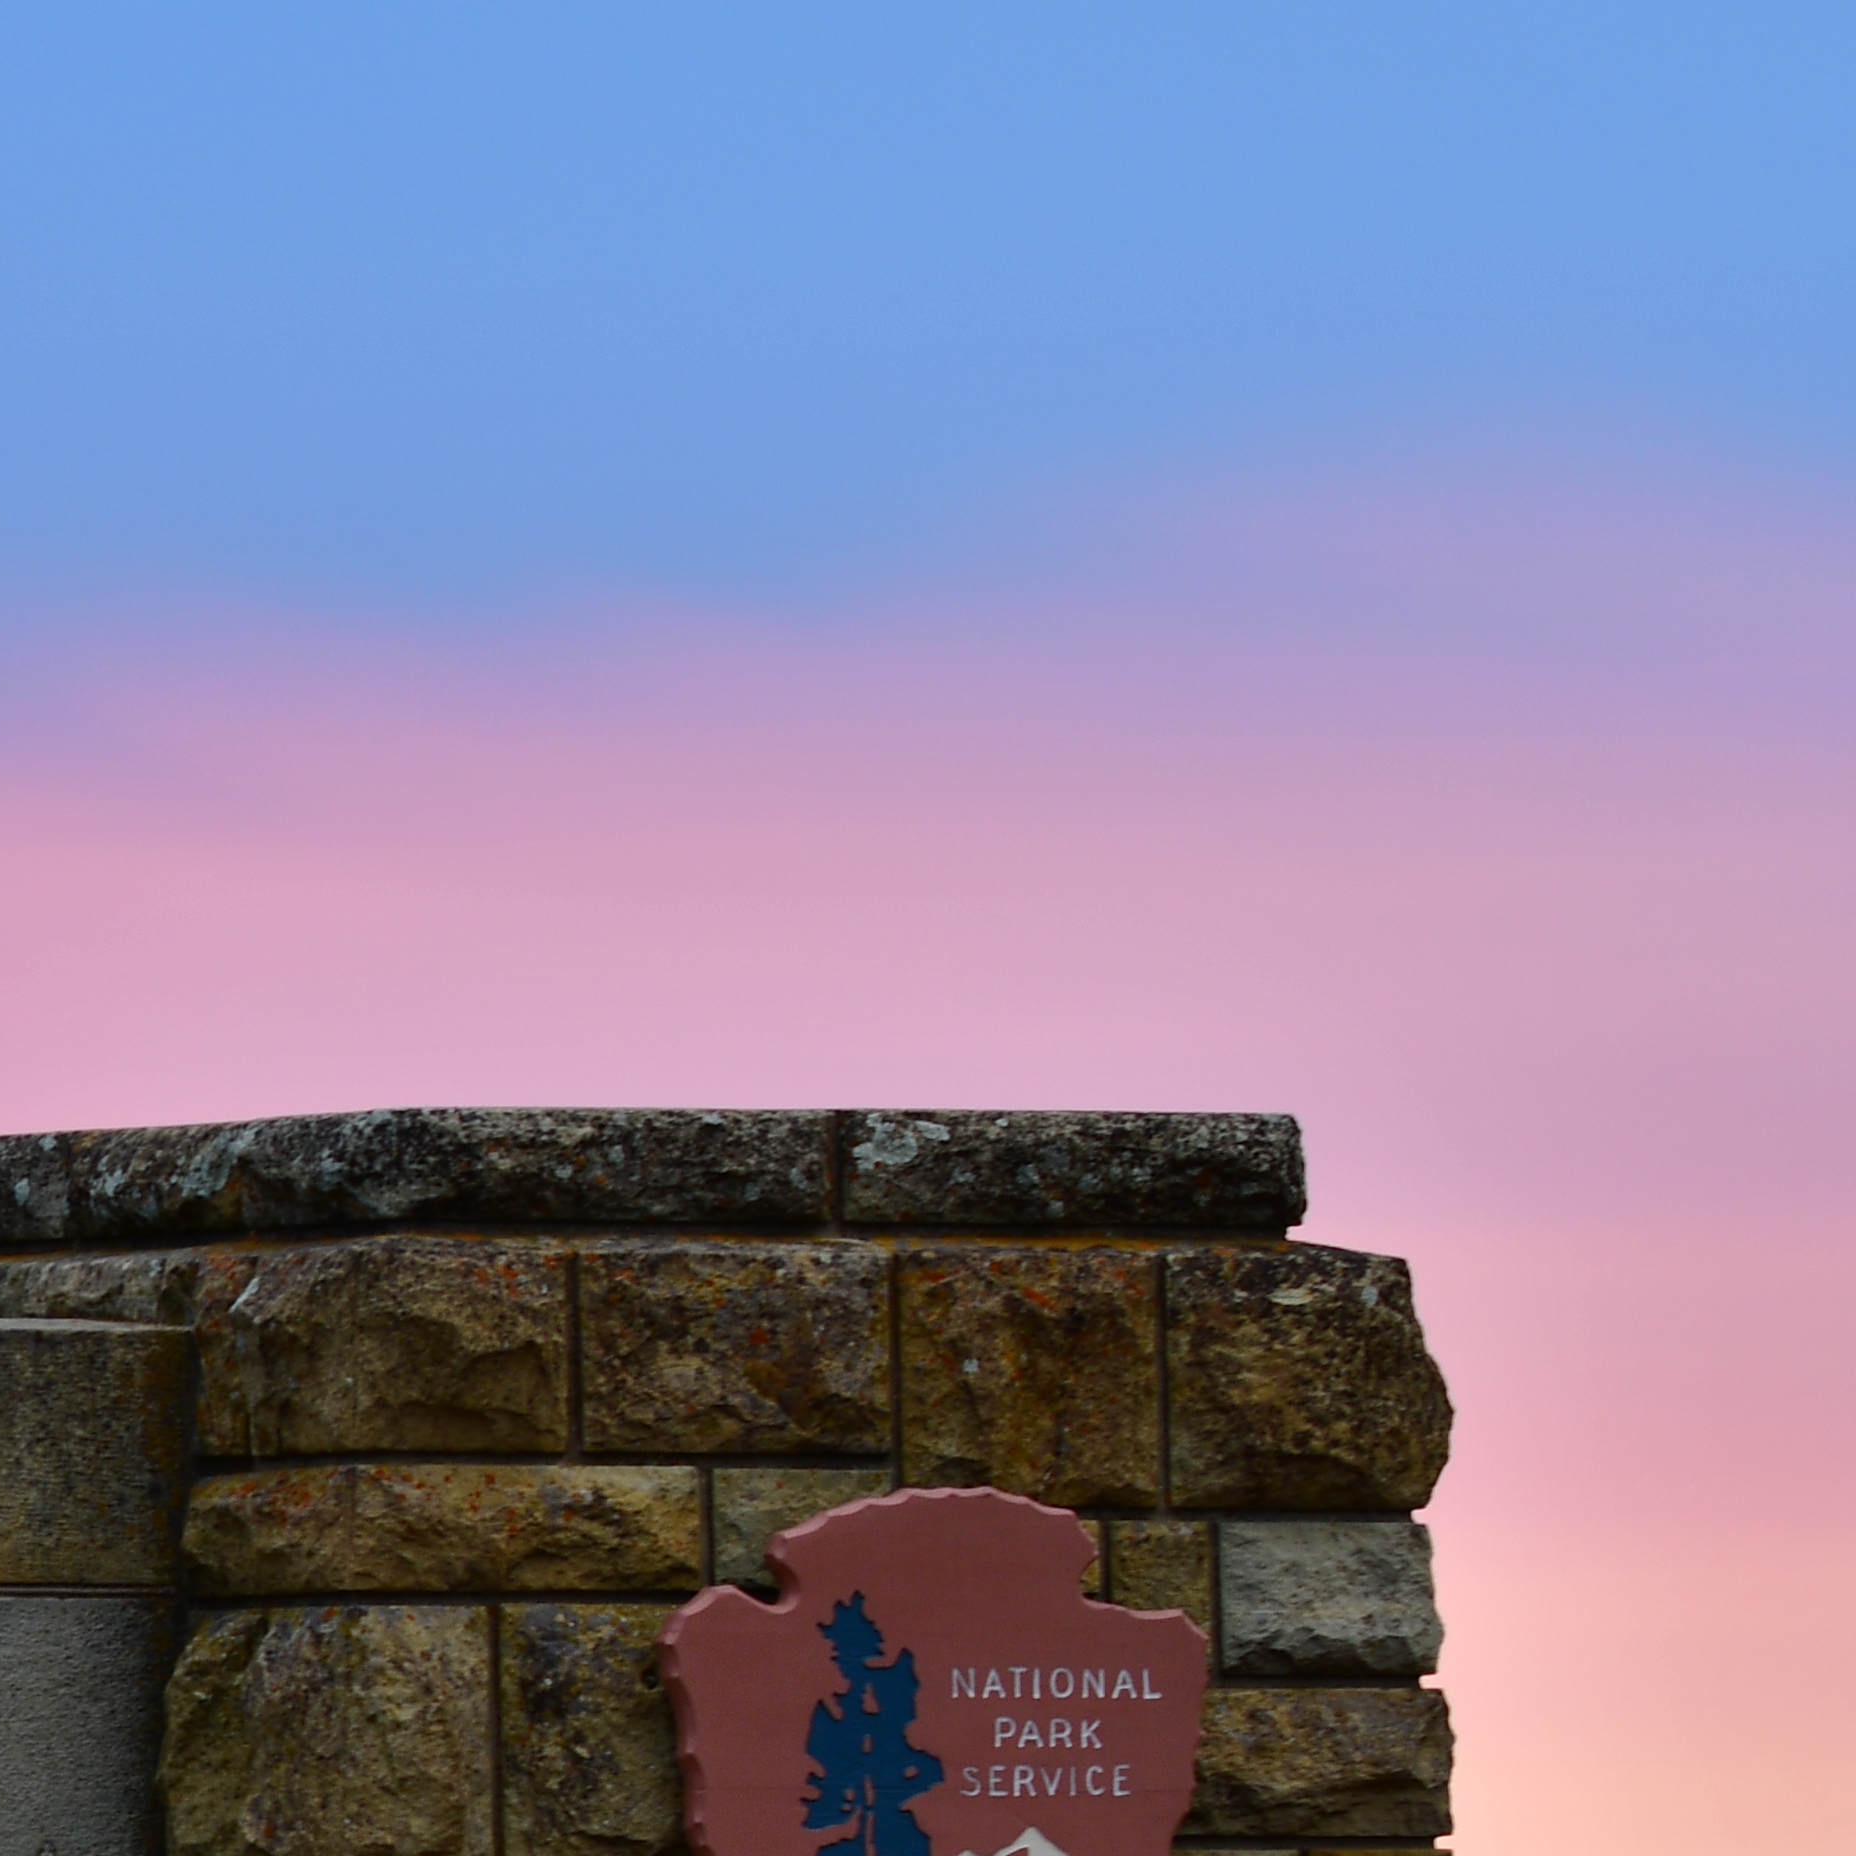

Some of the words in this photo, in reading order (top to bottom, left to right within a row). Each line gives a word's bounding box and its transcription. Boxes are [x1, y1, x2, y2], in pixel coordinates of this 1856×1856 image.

[950, 1666, 1162, 1701] NATIONAL
[993, 1716, 1103, 1749] PARK
[959, 1763, 1132, 1798] SERVICE
